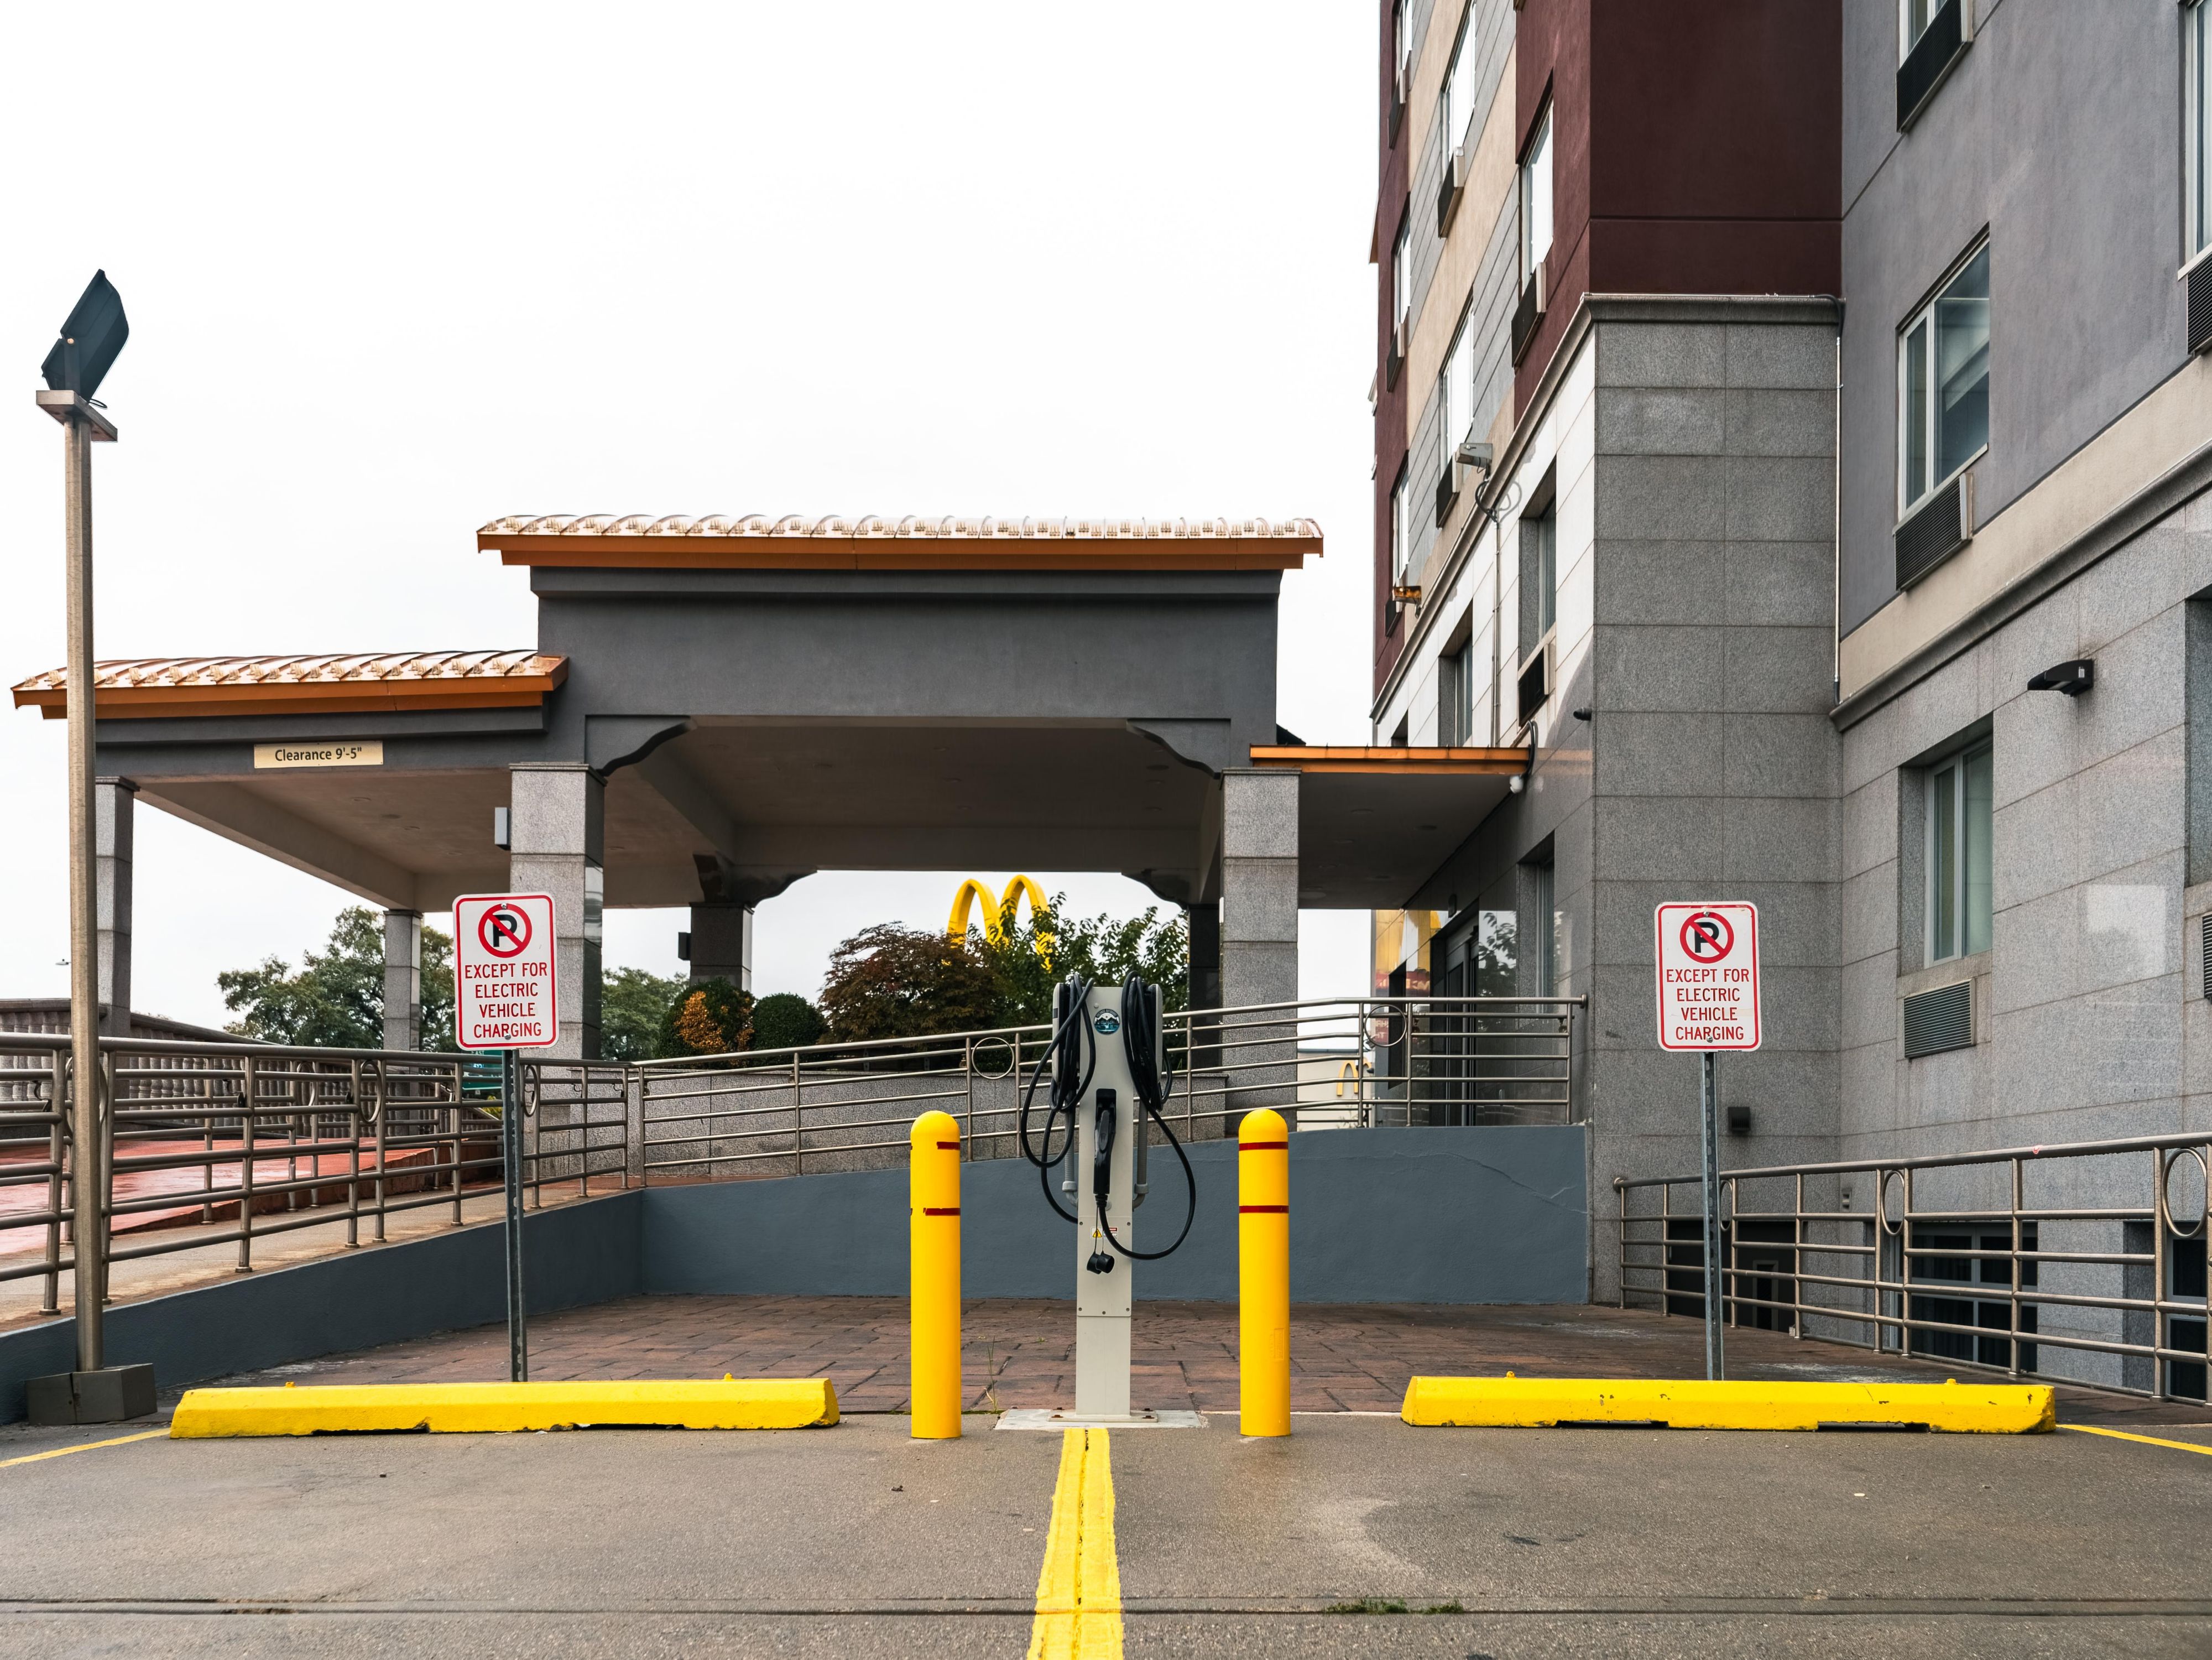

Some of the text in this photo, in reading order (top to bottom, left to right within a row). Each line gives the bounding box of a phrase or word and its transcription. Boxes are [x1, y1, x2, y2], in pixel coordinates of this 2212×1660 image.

[275, 746, 362, 761] Clearance 9'-5"
[465, 962, 547, 979] EXCEPT FOR
[1666, 969, 1750, 983] EXCEPT FOR
[475, 982, 538, 998] ELECTRIC
[1677, 988, 1740, 1002] ELECTRIC
[479, 1002, 536, 1018] VEHICLE
[1681, 1007, 1738, 1021] VEHICLE
[473, 1022, 541, 1038] CHARGING
[1676, 1026, 1744, 1040] CHARGING
